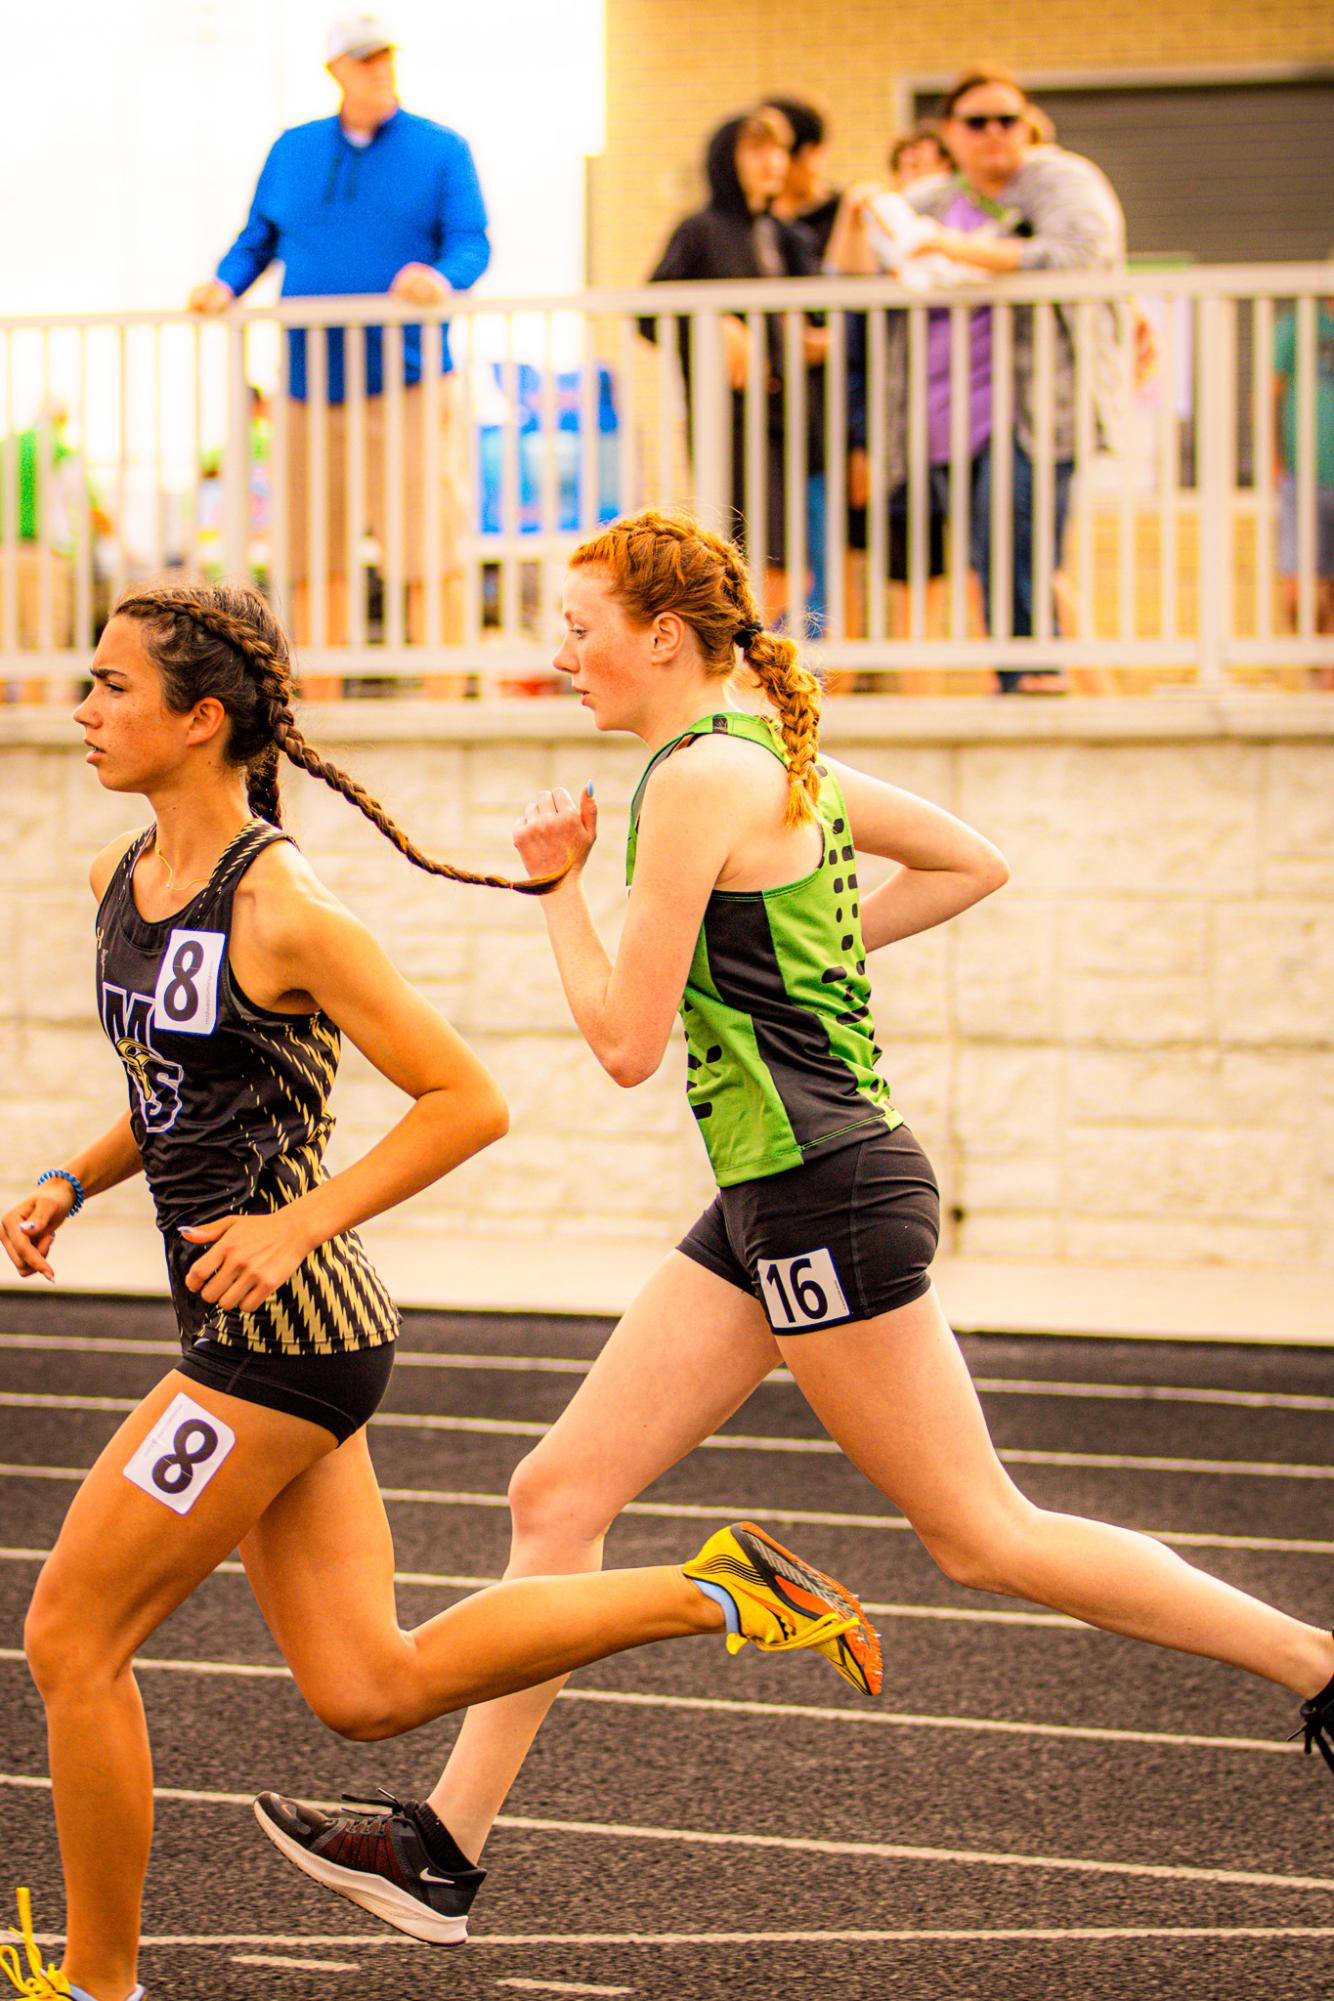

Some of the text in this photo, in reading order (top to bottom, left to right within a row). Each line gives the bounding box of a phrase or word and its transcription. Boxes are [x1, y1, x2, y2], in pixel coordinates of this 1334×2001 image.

[163, 940, 204, 1022] 8
[766, 1257, 828, 1324] 16
[151, 1418, 219, 1495] 8
